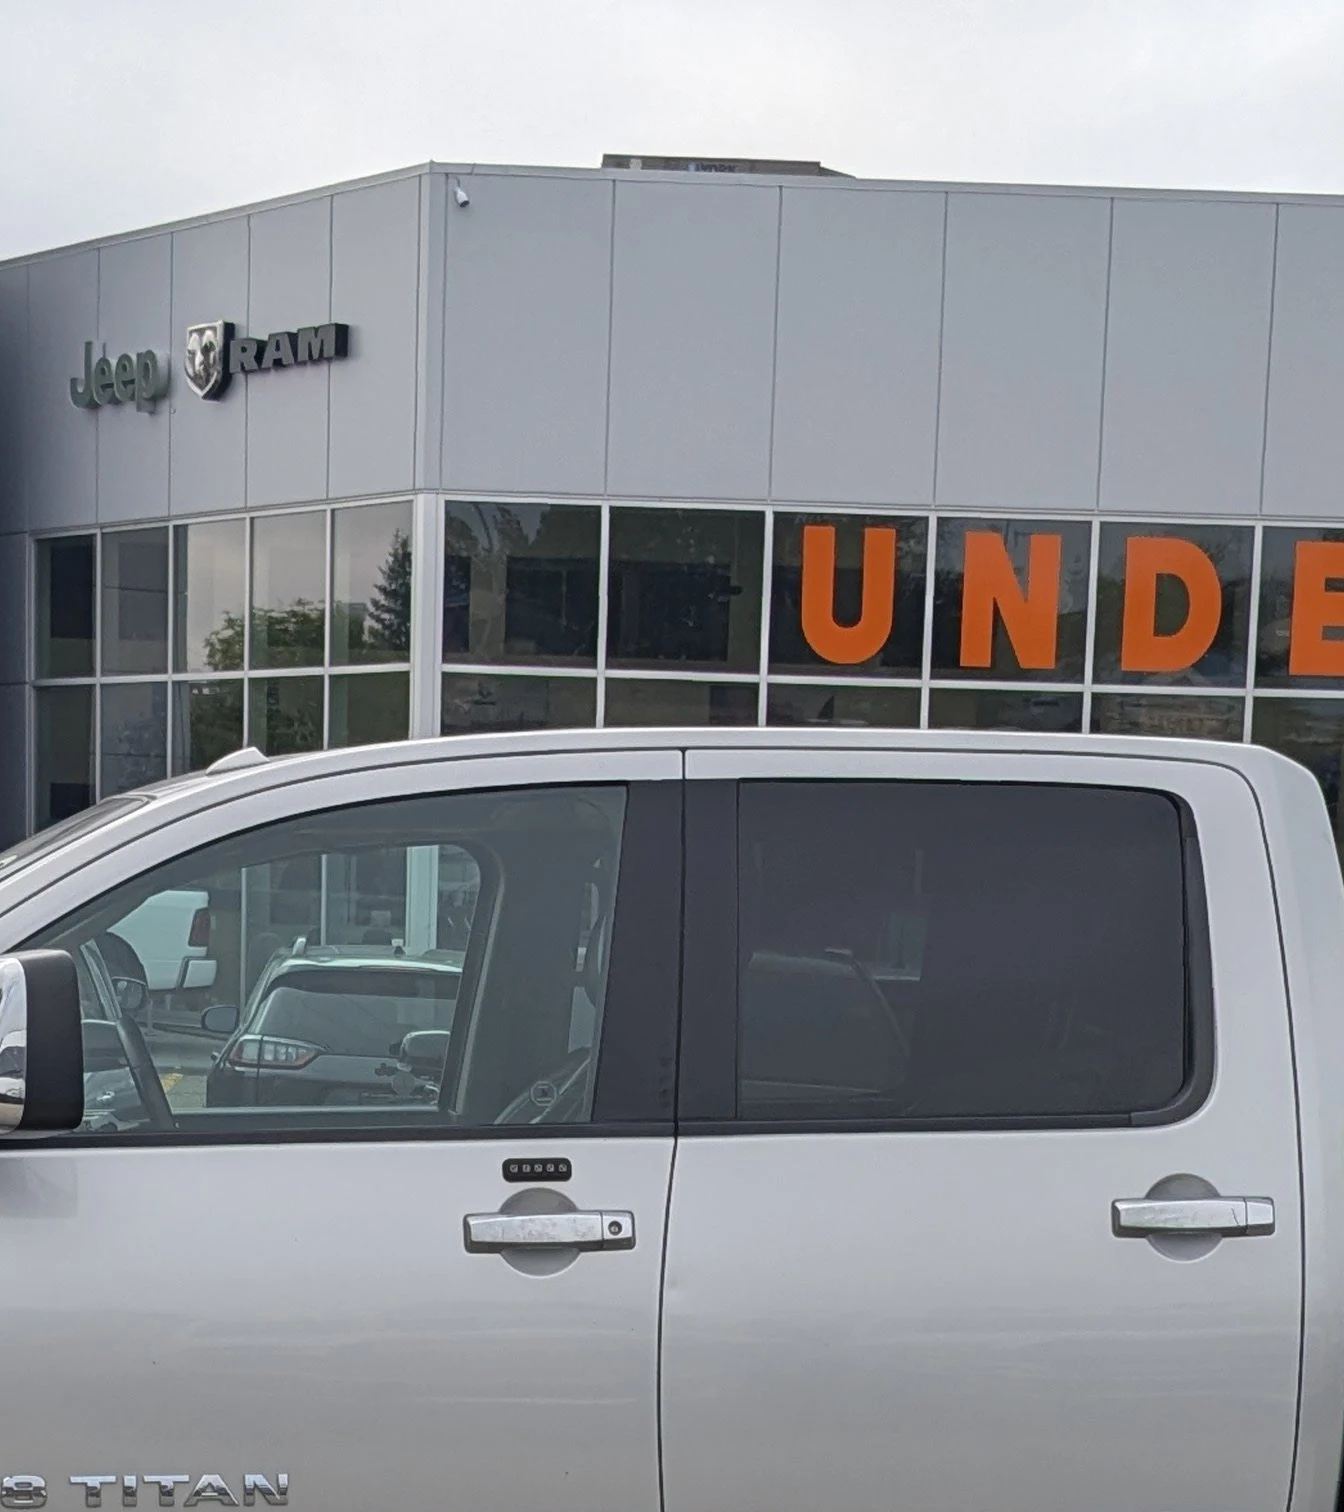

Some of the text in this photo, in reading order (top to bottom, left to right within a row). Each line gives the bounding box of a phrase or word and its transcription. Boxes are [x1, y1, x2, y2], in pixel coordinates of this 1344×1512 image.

[229, 322, 348, 373] RAM
[69, 340, 166, 412] Jeep
[69, 1473, 289, 1508] TITAN
